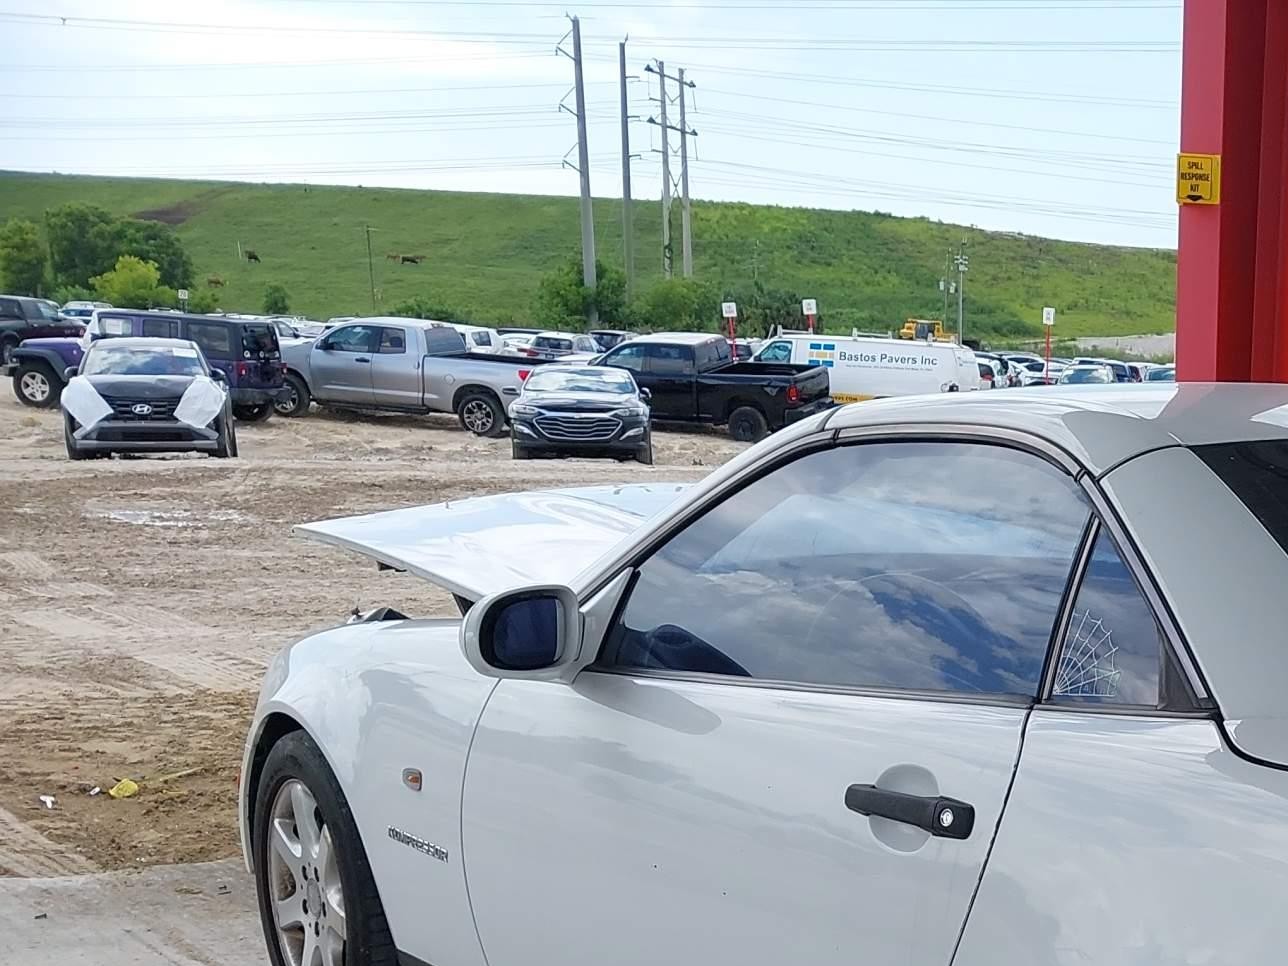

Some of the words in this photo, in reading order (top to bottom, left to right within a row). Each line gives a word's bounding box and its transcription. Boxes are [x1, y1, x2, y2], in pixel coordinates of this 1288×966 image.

[1187, 161, 1204, 170] SPILL
[1181, 172, 1210, 182] RESPONSE
[1190, 184, 1200, 192] KIT
[839, 352, 876, 362] Bastos
[880, 353, 917, 364] Pavers
[921, 355, 938, 366] Inc
